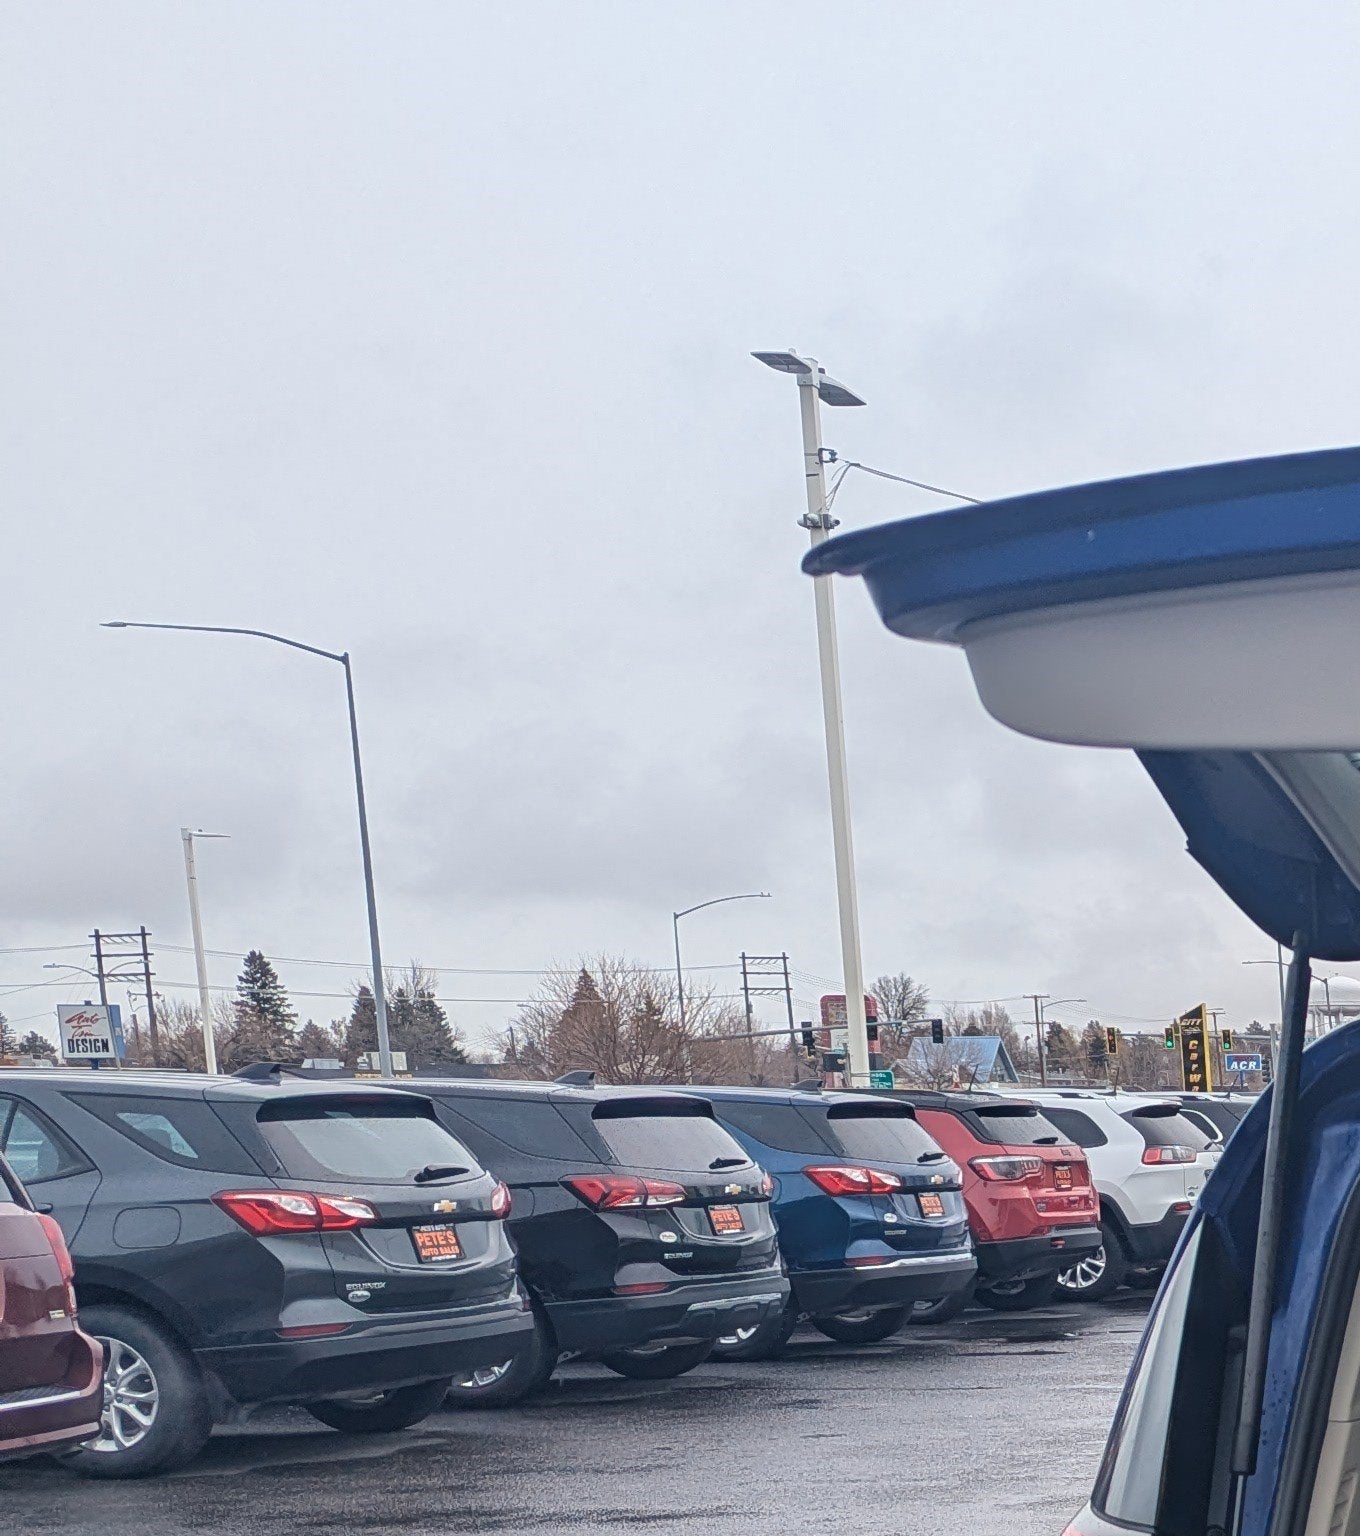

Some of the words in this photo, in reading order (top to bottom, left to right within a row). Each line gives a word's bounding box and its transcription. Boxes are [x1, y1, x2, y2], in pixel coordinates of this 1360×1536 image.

[67, 1038, 109, 1053] DESIGN
[1231, 1060, 1257, 1070] ACR
[415, 1230, 457, 1246] PETE'S
